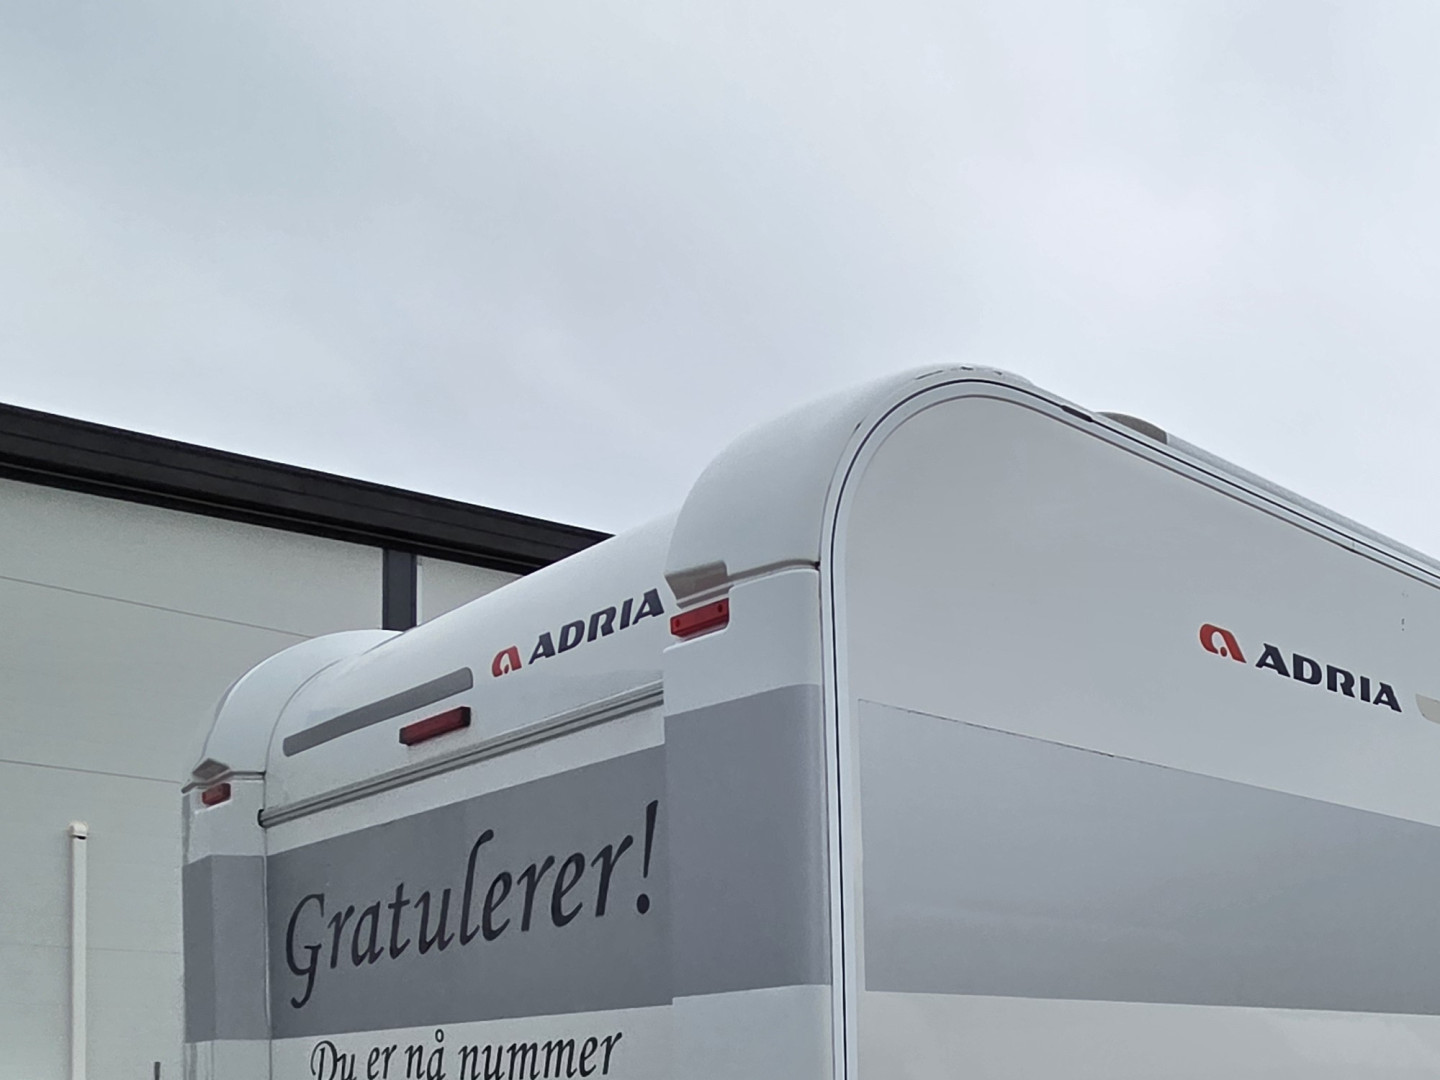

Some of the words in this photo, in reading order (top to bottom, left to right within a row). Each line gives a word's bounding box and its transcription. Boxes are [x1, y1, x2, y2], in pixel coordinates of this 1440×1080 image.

[528, 587, 665, 665] ADRIA
[1255, 642, 1402, 713] ADRIA
[285, 799, 659, 1009] Gratulerer!
[366, 1044, 397, 1080] er
